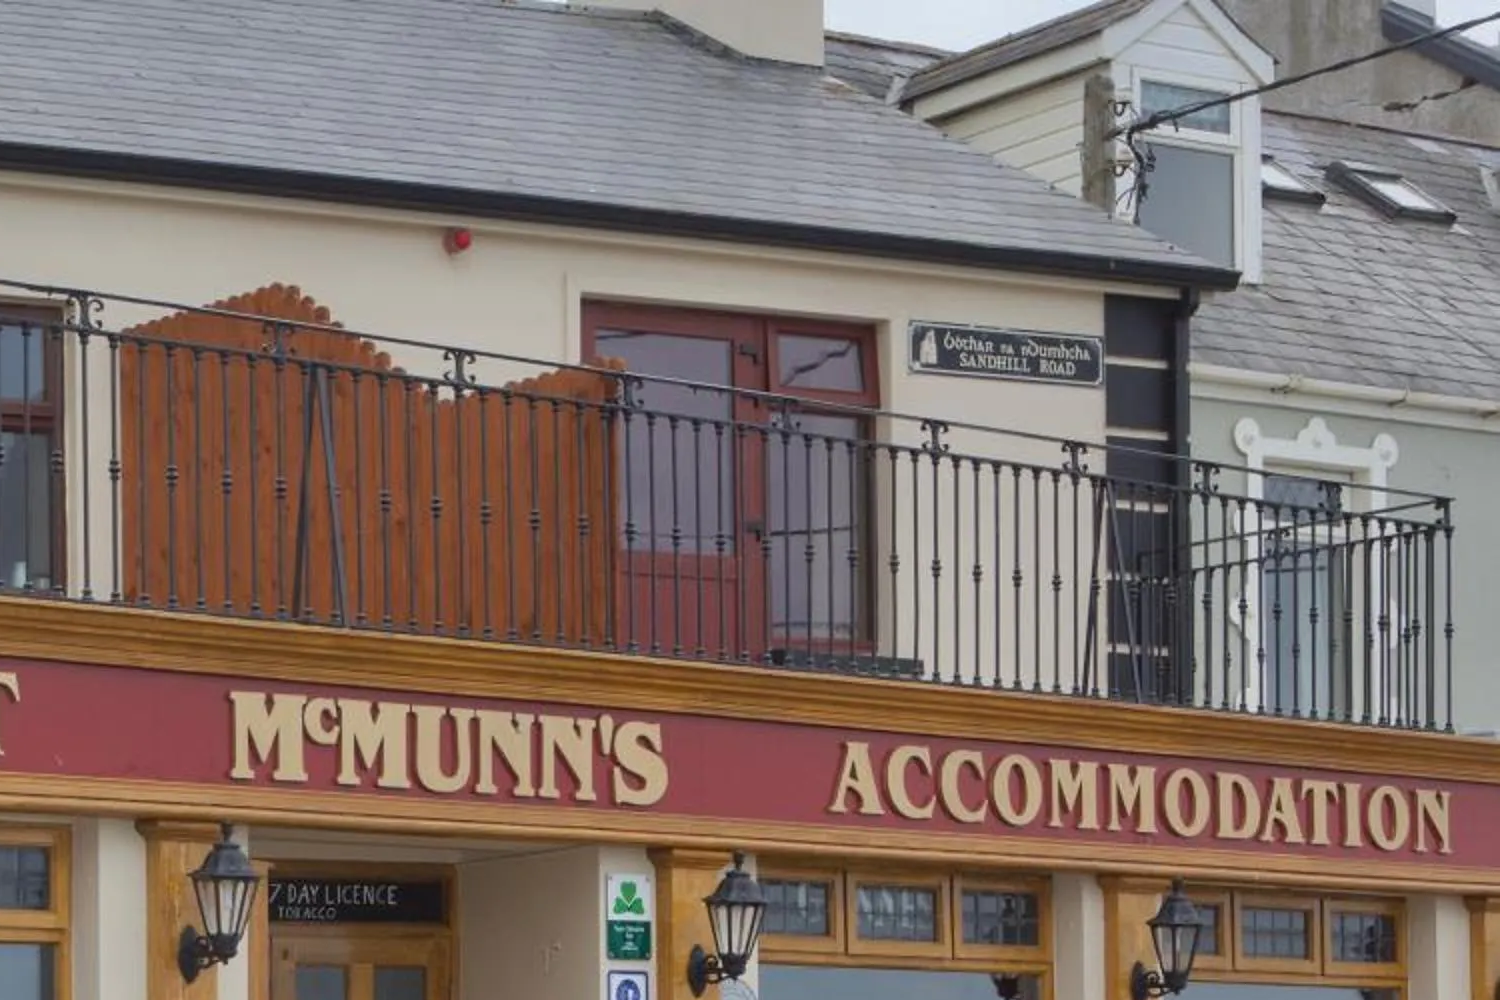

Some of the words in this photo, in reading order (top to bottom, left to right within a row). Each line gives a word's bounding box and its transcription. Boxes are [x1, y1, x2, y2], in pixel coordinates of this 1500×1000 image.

[959, 353, 1031, 373] SANDHILL
[1039, 360, 1076, 376] ROAD
[828, 740, 1453, 855] ACCOMMODATION
[268, 883, 282, 903] 7
[287, 884, 319, 904] DAY
[325, 884, 399, 905] LICENCE
[278, 907, 337, 919] TOBACCO
